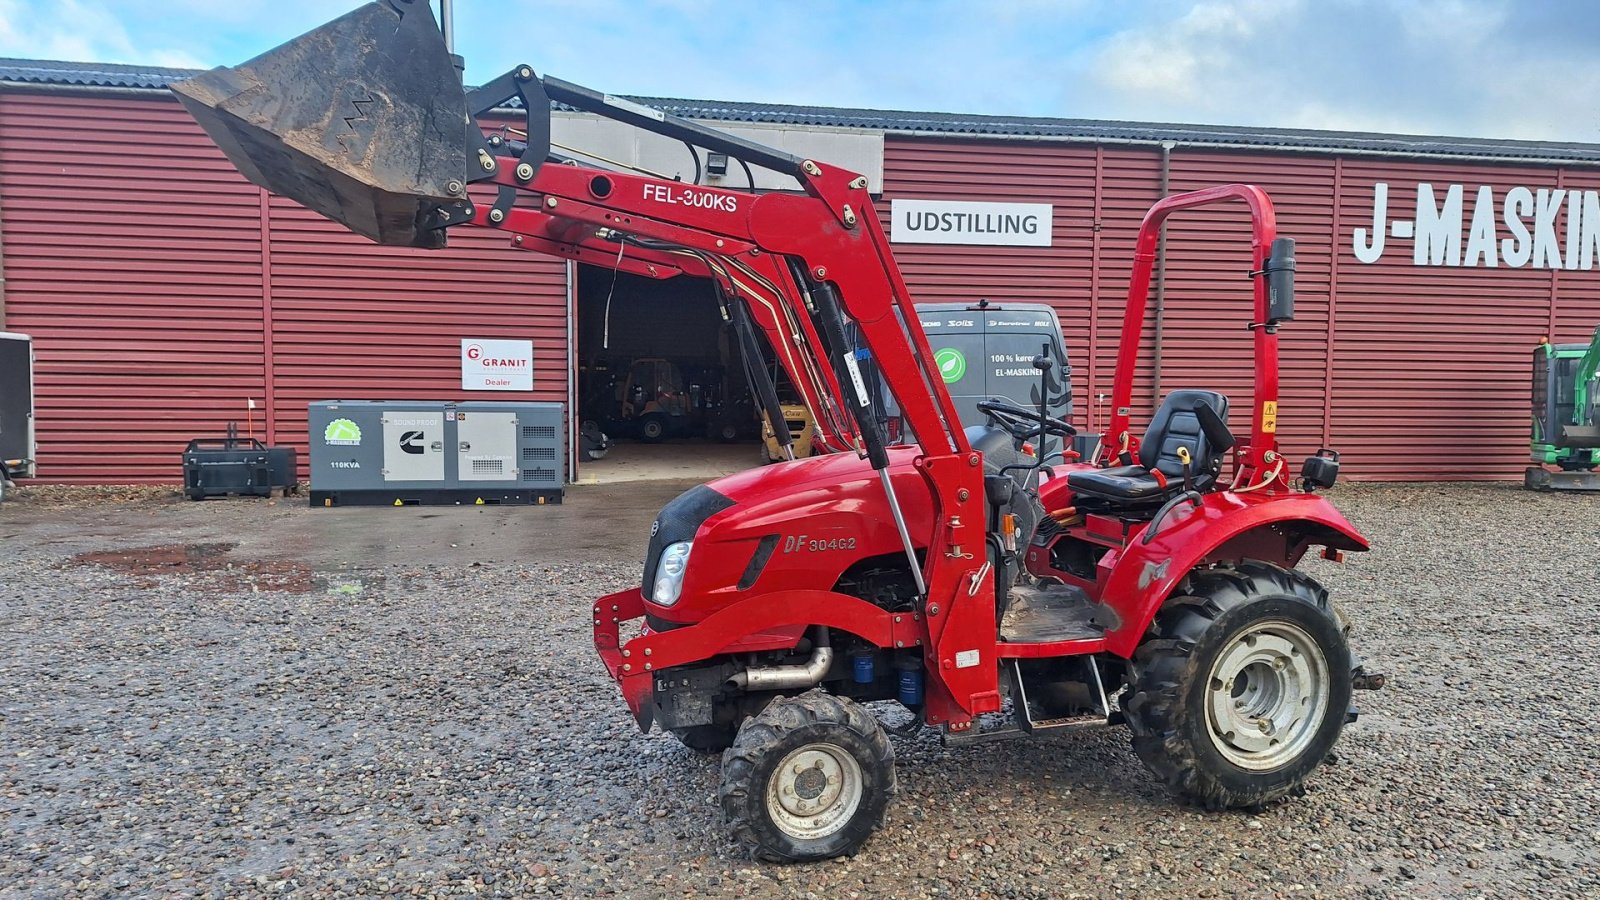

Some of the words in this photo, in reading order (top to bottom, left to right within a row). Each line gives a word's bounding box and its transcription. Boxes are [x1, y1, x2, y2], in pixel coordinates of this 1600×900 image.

[643, 183, 737, 212] FEL-300KS
[906, 211, 1038, 235] UDSTILLING
[482, 358, 527, 367] GRANIT
[990, 354, 1005, 363] 100
[1005, 354, 1014, 363] %
[485, 378, 511, 386] Dealer
[330, 461, 361, 469] 110KVA
[783, 535, 809, 554] DF
[808, 537, 857, 552] 304G2
